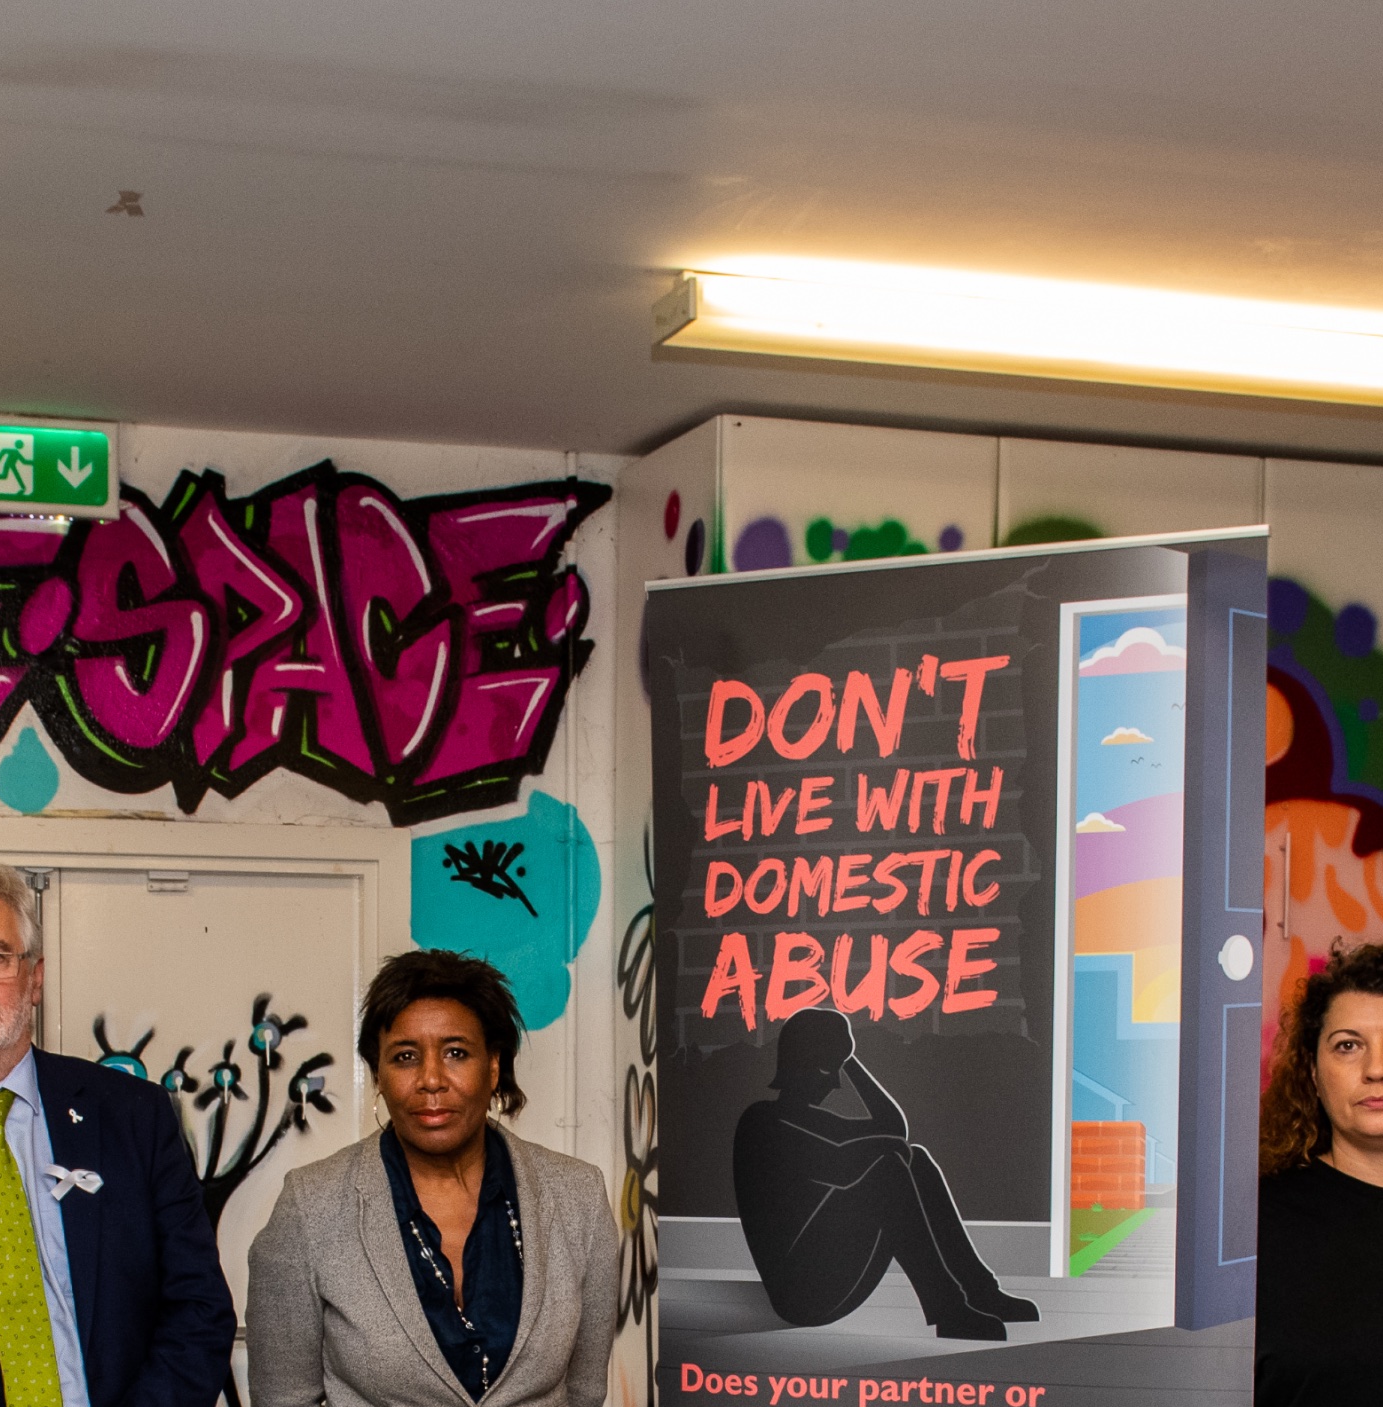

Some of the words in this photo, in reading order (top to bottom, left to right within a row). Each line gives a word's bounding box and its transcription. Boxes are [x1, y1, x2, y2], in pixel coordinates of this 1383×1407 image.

[705, 654, 1010, 768] DON'T
[705, 776, 834, 841] LIVE
[856, 766, 1004, 834] WITH
[704, 849, 1001, 918] DOMESTIC
[701, 928, 1001, 1032] ABUSE
[681, 1363, 759, 1397] Does
[768, 1375, 848, 1406] your
